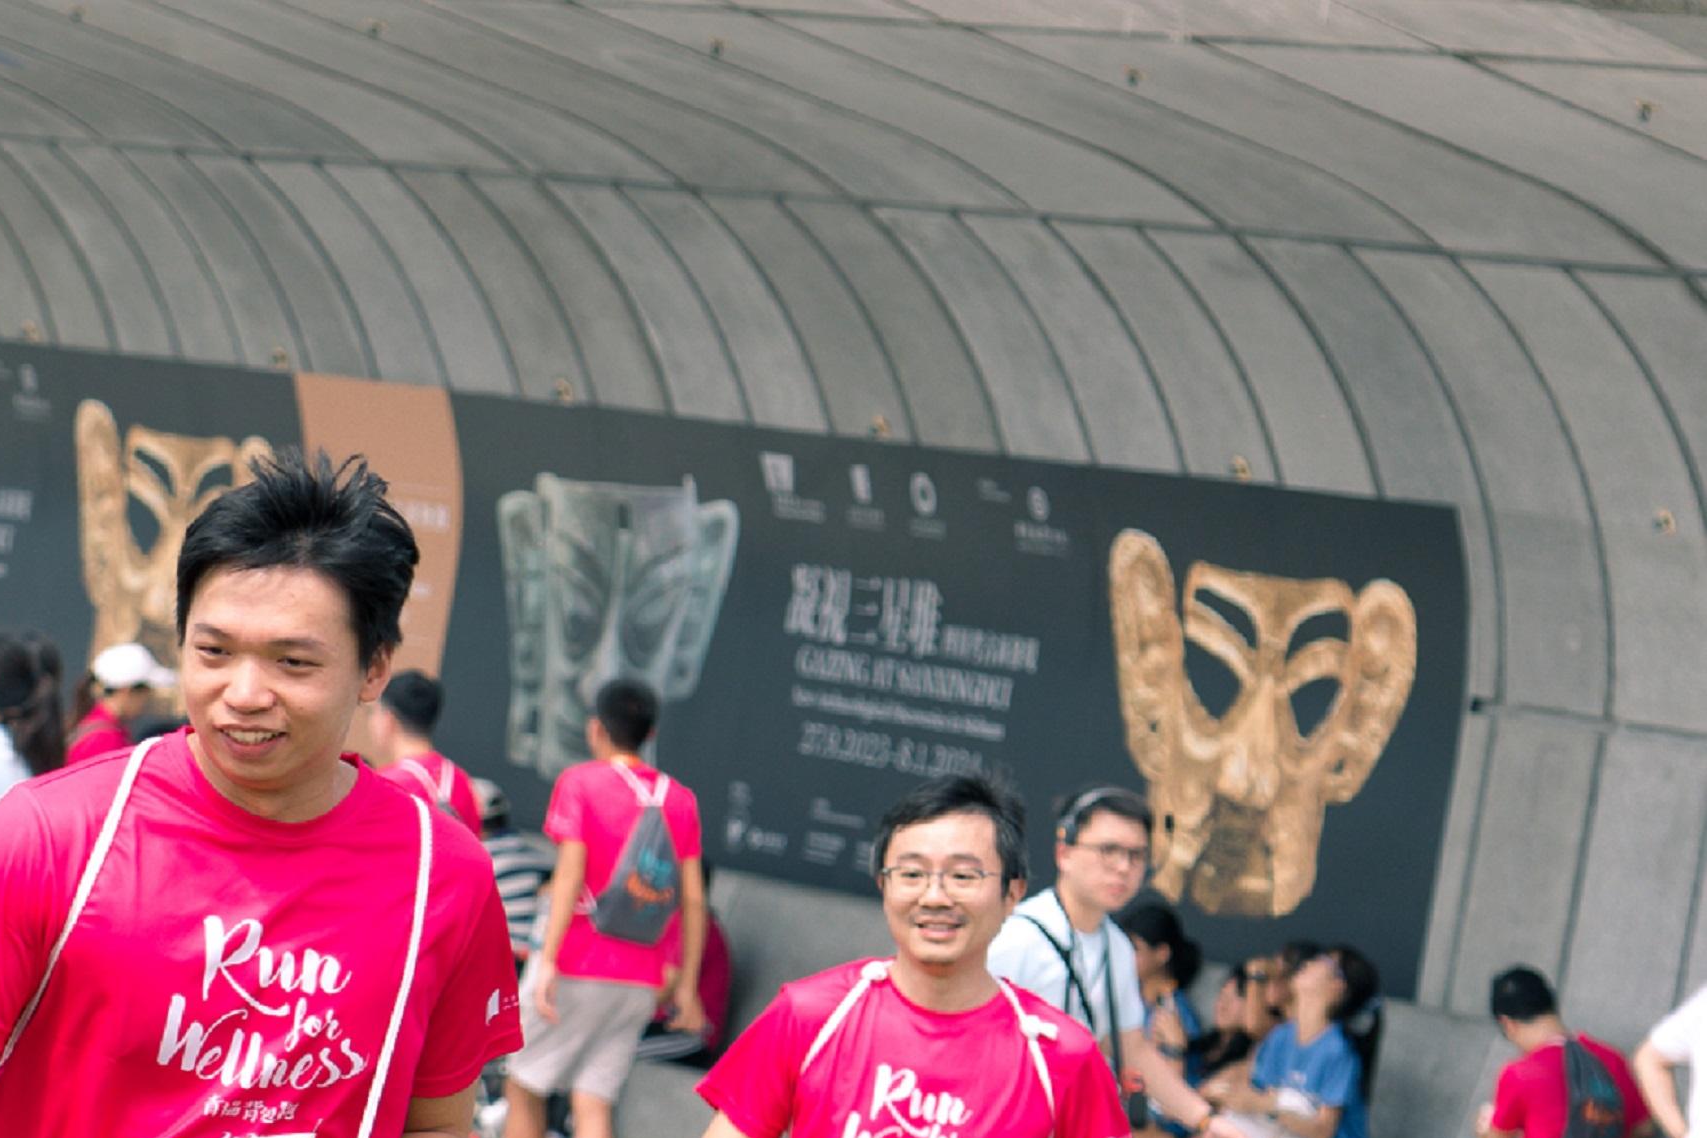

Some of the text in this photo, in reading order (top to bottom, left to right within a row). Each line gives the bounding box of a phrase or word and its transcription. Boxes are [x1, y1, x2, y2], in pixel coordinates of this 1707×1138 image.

[202, 914, 351, 1016] Run
[157, 993, 370, 1090] Wellness
[284, 998, 342, 1051] for
[871, 1063, 974, 1138] Run
